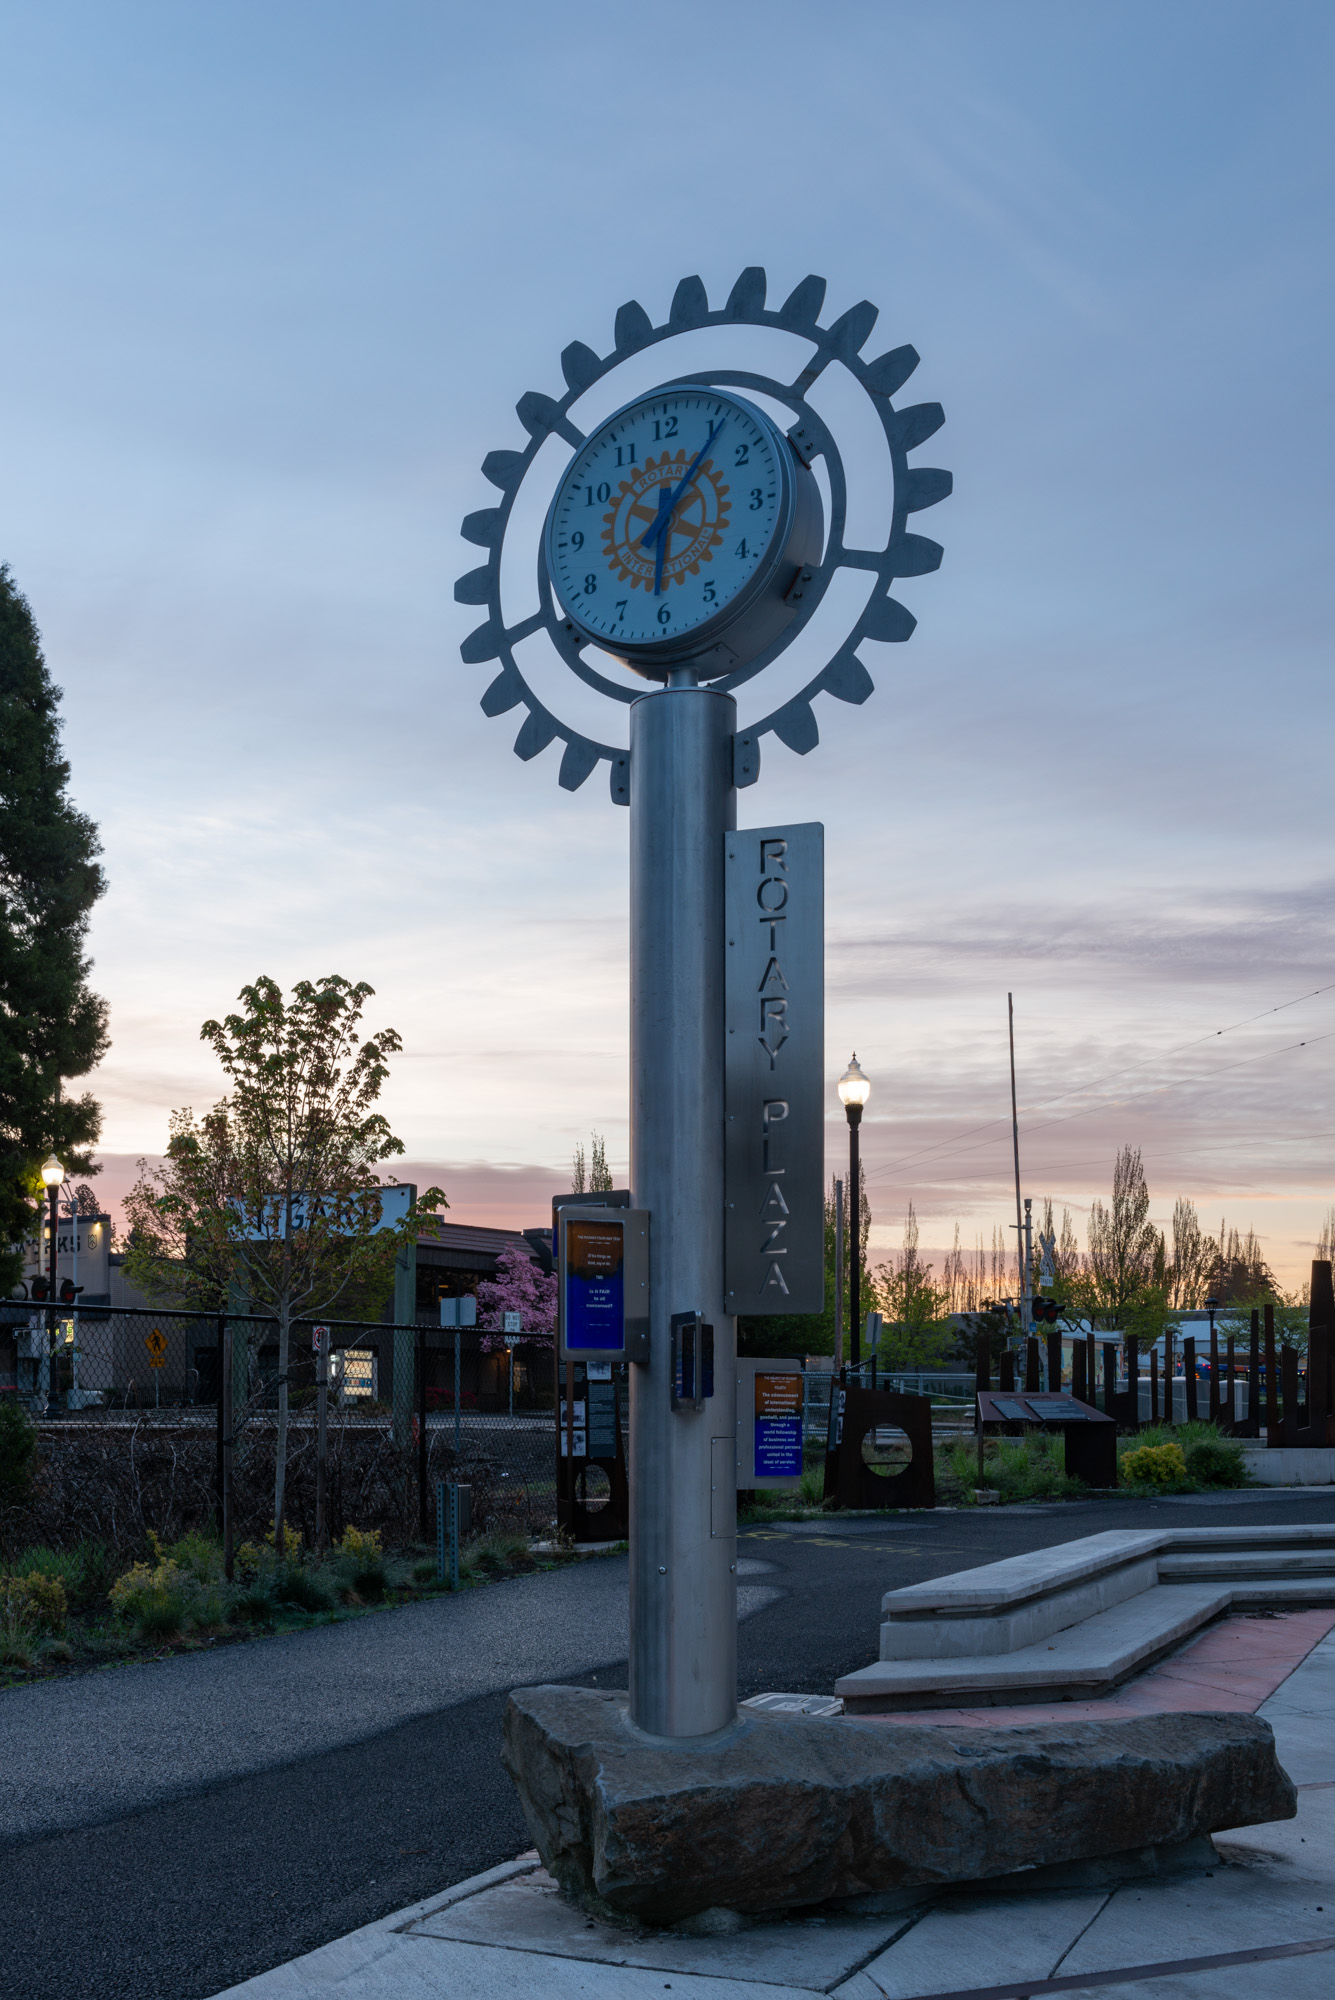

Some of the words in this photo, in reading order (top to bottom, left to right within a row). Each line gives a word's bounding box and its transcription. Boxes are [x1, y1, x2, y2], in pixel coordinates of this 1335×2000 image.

[652, 416, 679, 442] 12
[614, 443, 638, 468] 11
[735, 444, 749, 467] 2
[584, 482, 611, 507] 10
[749, 488, 763, 510] 3
[571, 531, 584, 552] 9
[735, 538, 749, 560] 4
[584, 574, 597, 595] 8
[703, 580, 716, 602] 5
[615, 600, 628, 622] 7
[657, 602, 671, 624] 6
[757, 838, 790, 1071] ROTARY
[758, 1099, 790, 1295] PLAZA
